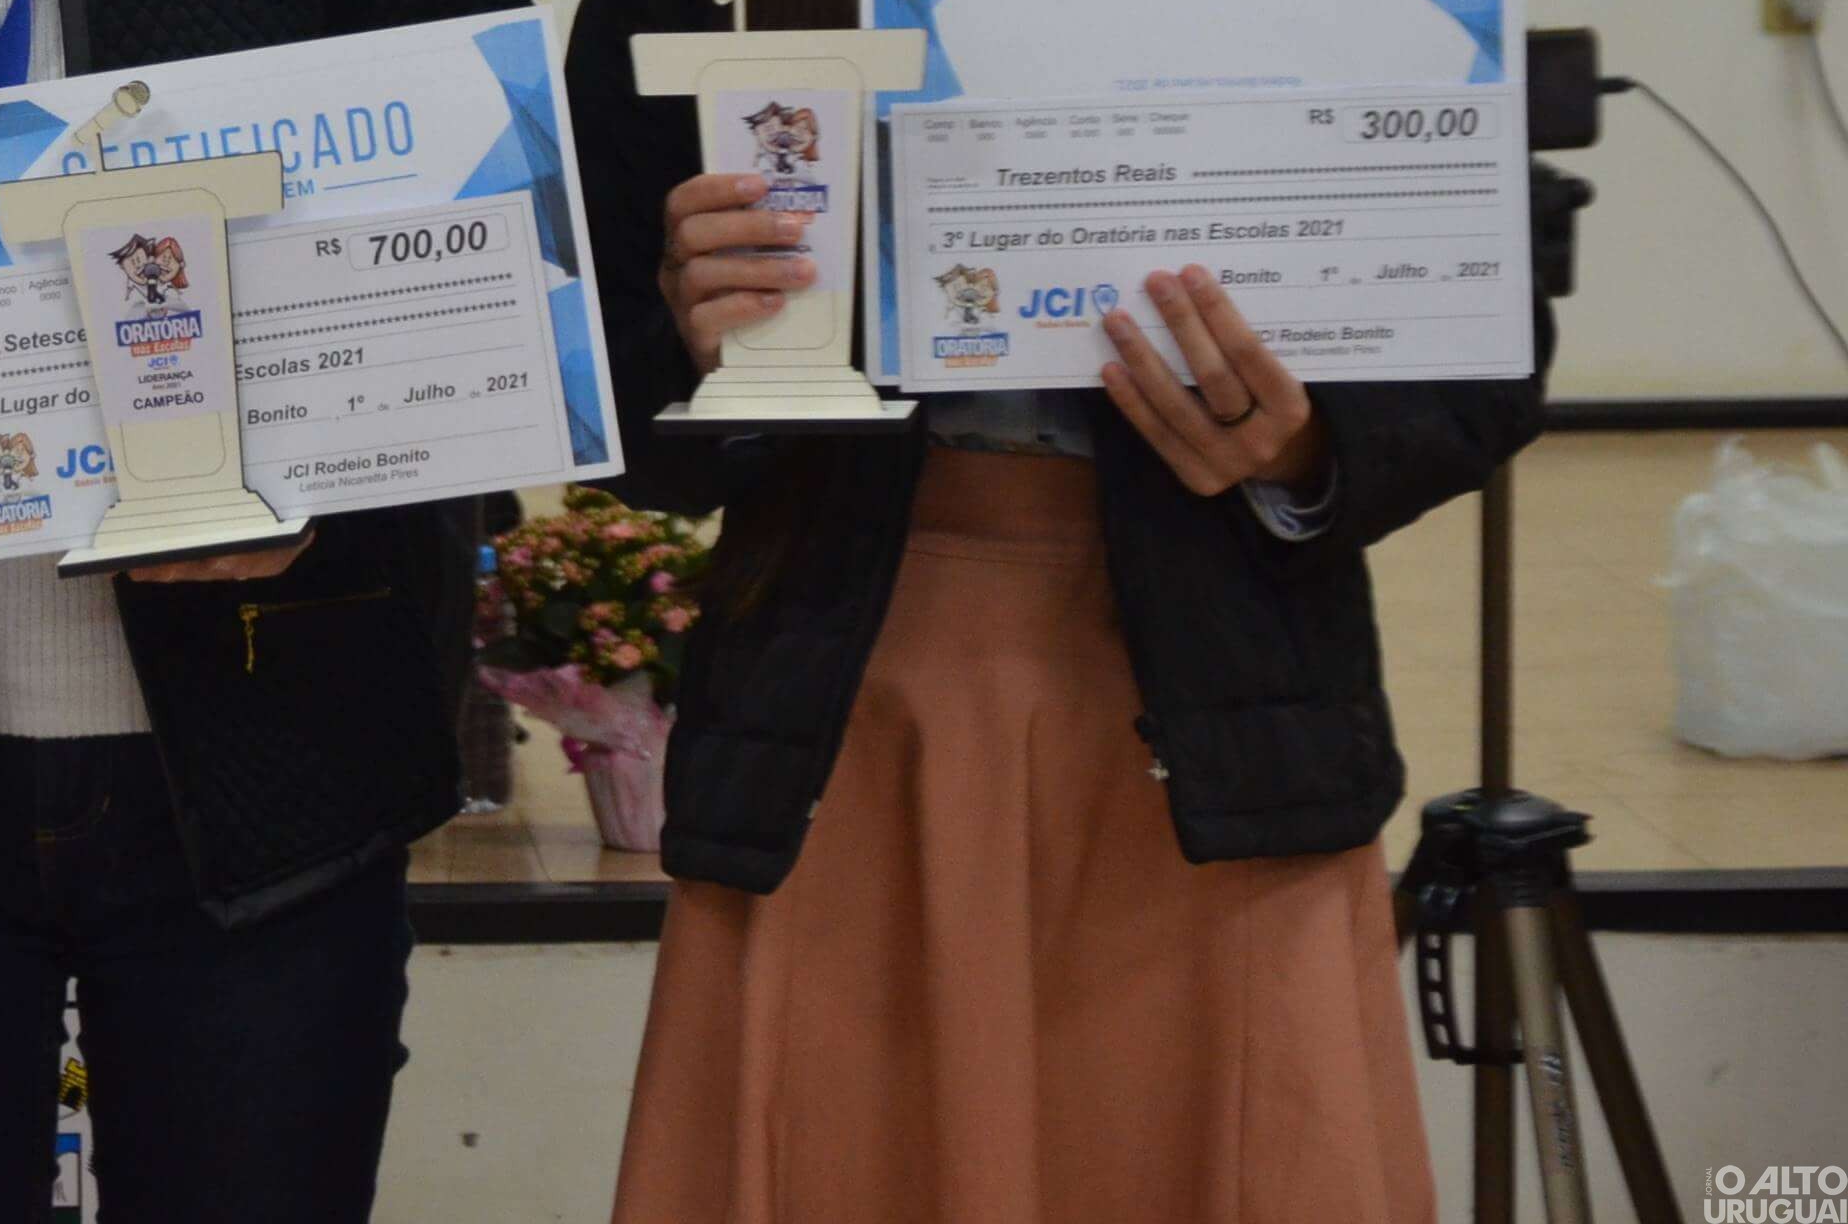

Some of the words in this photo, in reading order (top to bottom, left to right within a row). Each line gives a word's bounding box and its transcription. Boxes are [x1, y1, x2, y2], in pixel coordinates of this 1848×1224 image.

[1361, 107, 1479, 142] 300,00
[998, 166, 1107, 187] Trezentos
[1113, 163, 1178, 184] Reais
[316, 238, 342, 256] R$
[369, 220, 488, 266] 700,00
[970, 230, 1029, 252] Lugar
[1038, 228, 1064, 246] do
[1071, 225, 1157, 245] Oratória
[1164, 225, 1201, 242] nas
[1209, 221, 1290, 241] Escolas
[1297, 220, 1345, 238] 2021
[1220, 269, 1282, 285] Bonito
[1376, 263, 1429, 280] Julho
[1457, 262, 1502, 278] 2021
[1018, 287, 1086, 318] JCI
[119, 316, 201, 345] ORATÓRIA
[1279, 328, 1336, 343] Rodeio
[1341, 326, 1395, 340] Bonito
[235, 357, 310, 382] Escolas
[318, 347, 365, 371] 2021
[0, 391, 59, 416] Lugar
[65, 386, 91, 405] do
[133, 390, 205, 411] CAMPEÃO
[247, 403, 308, 425] Bonito
[347, 394, 366, 413] 1º
[403, 382, 457, 405] Julho
[486, 371, 530, 394] 2021
[283, 464, 310, 480] JCI
[314, 458, 373, 476] Rodeio
[376, 449, 431, 468] Bonito
